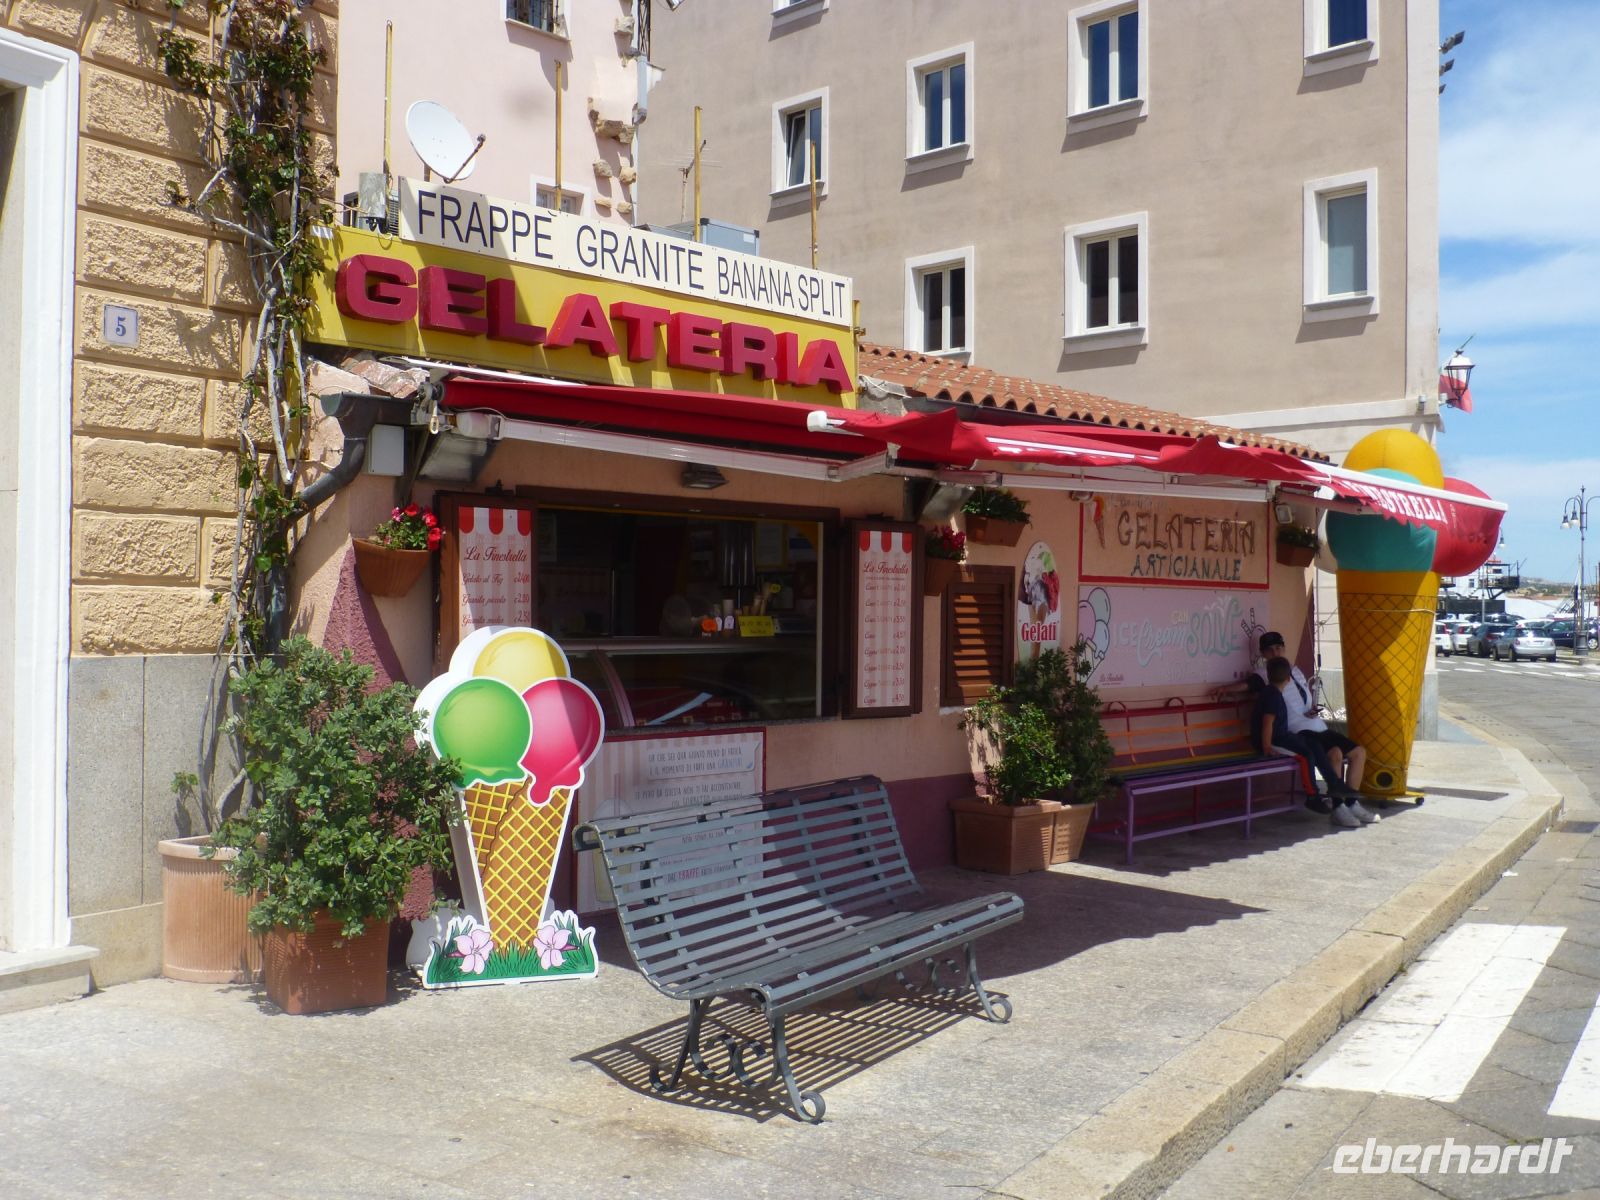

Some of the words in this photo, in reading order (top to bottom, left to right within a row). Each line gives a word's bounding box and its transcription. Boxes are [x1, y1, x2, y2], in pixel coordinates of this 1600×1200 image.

[576, 225, 704, 290] GRANITE
[717, 257, 797, 309] BANANA
[798, 276, 845, 318] SPLIT
[116, 316, 126, 337] 5
[335, 253, 854, 395] GELATERIA
[1118, 510, 1255, 557] GELATERIA
[465, 546, 480, 562] La
[864, 561, 875, 573] La
[1021, 622, 1057, 642] Gelati
[1114, 623, 1137, 648] ICE
